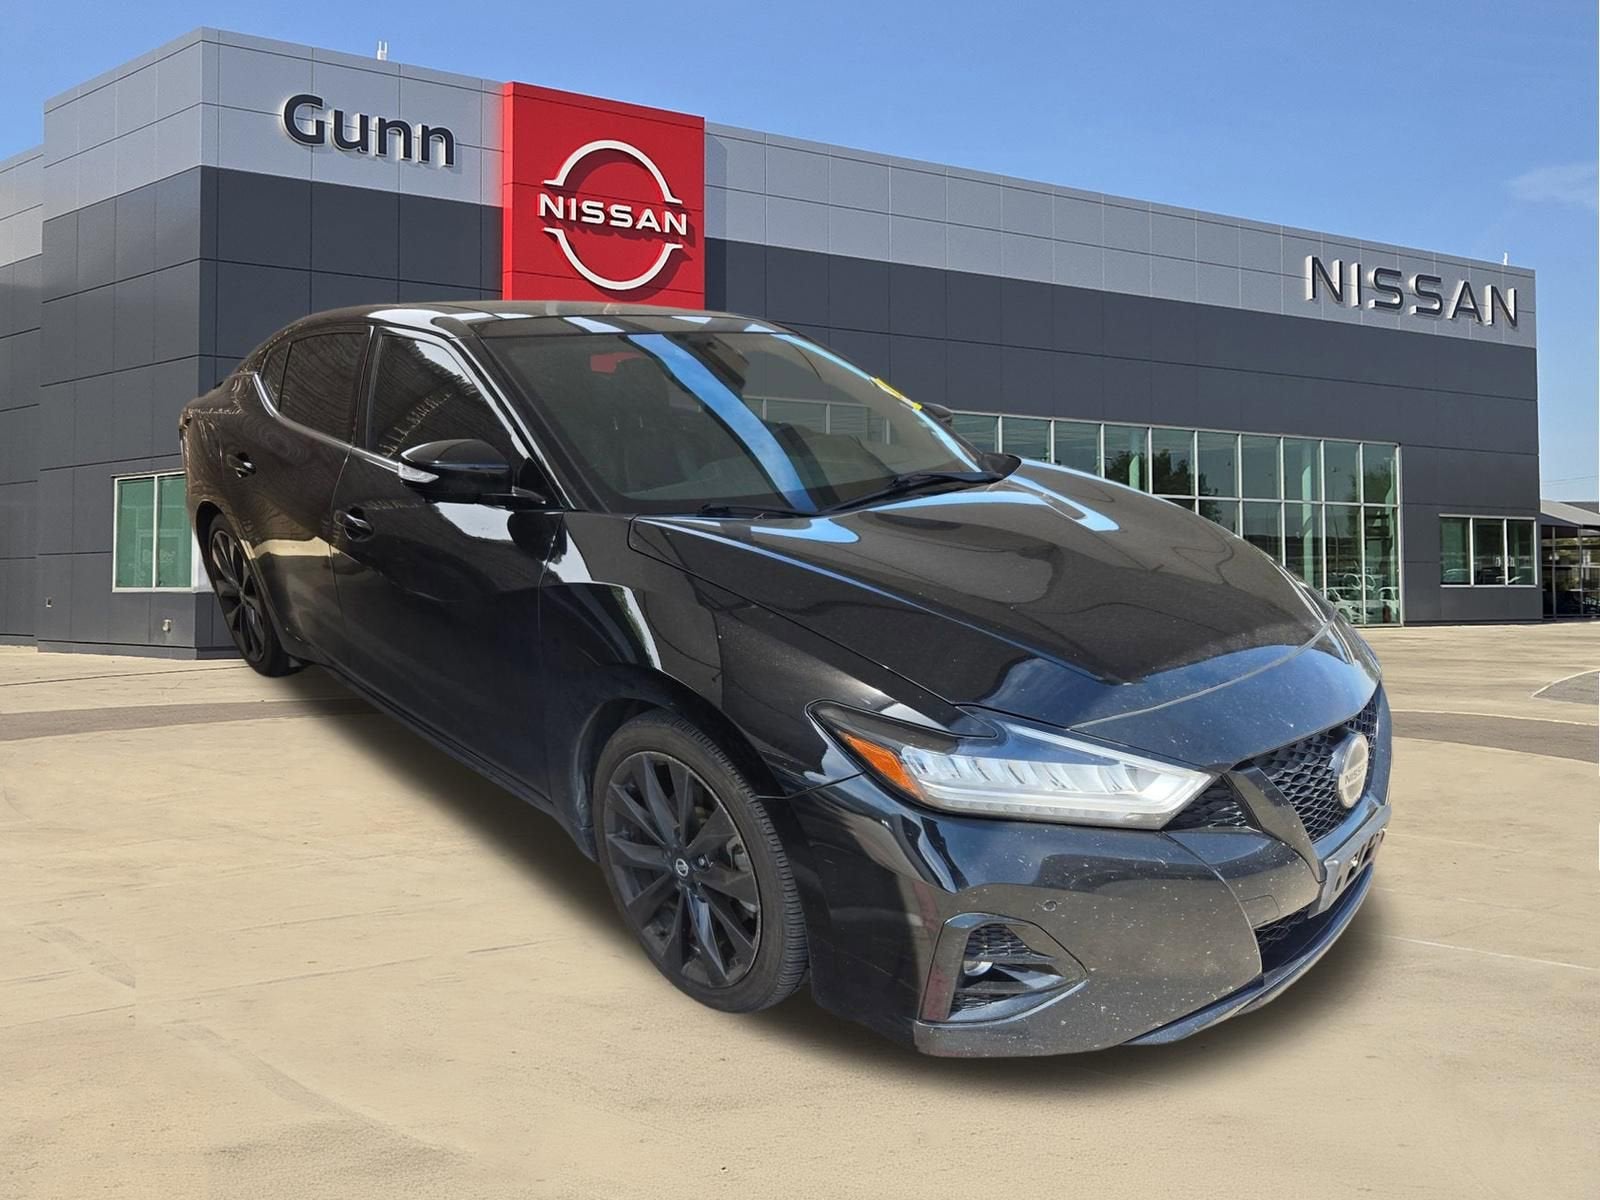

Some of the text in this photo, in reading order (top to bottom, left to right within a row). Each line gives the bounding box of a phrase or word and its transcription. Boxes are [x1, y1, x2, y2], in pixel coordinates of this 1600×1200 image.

[282, 94, 456, 168] Gunn
[538, 192, 688, 236] NISSAN
[1305, 255, 1518, 327] NISSAN
[1344, 762, 1366, 785] NISS
